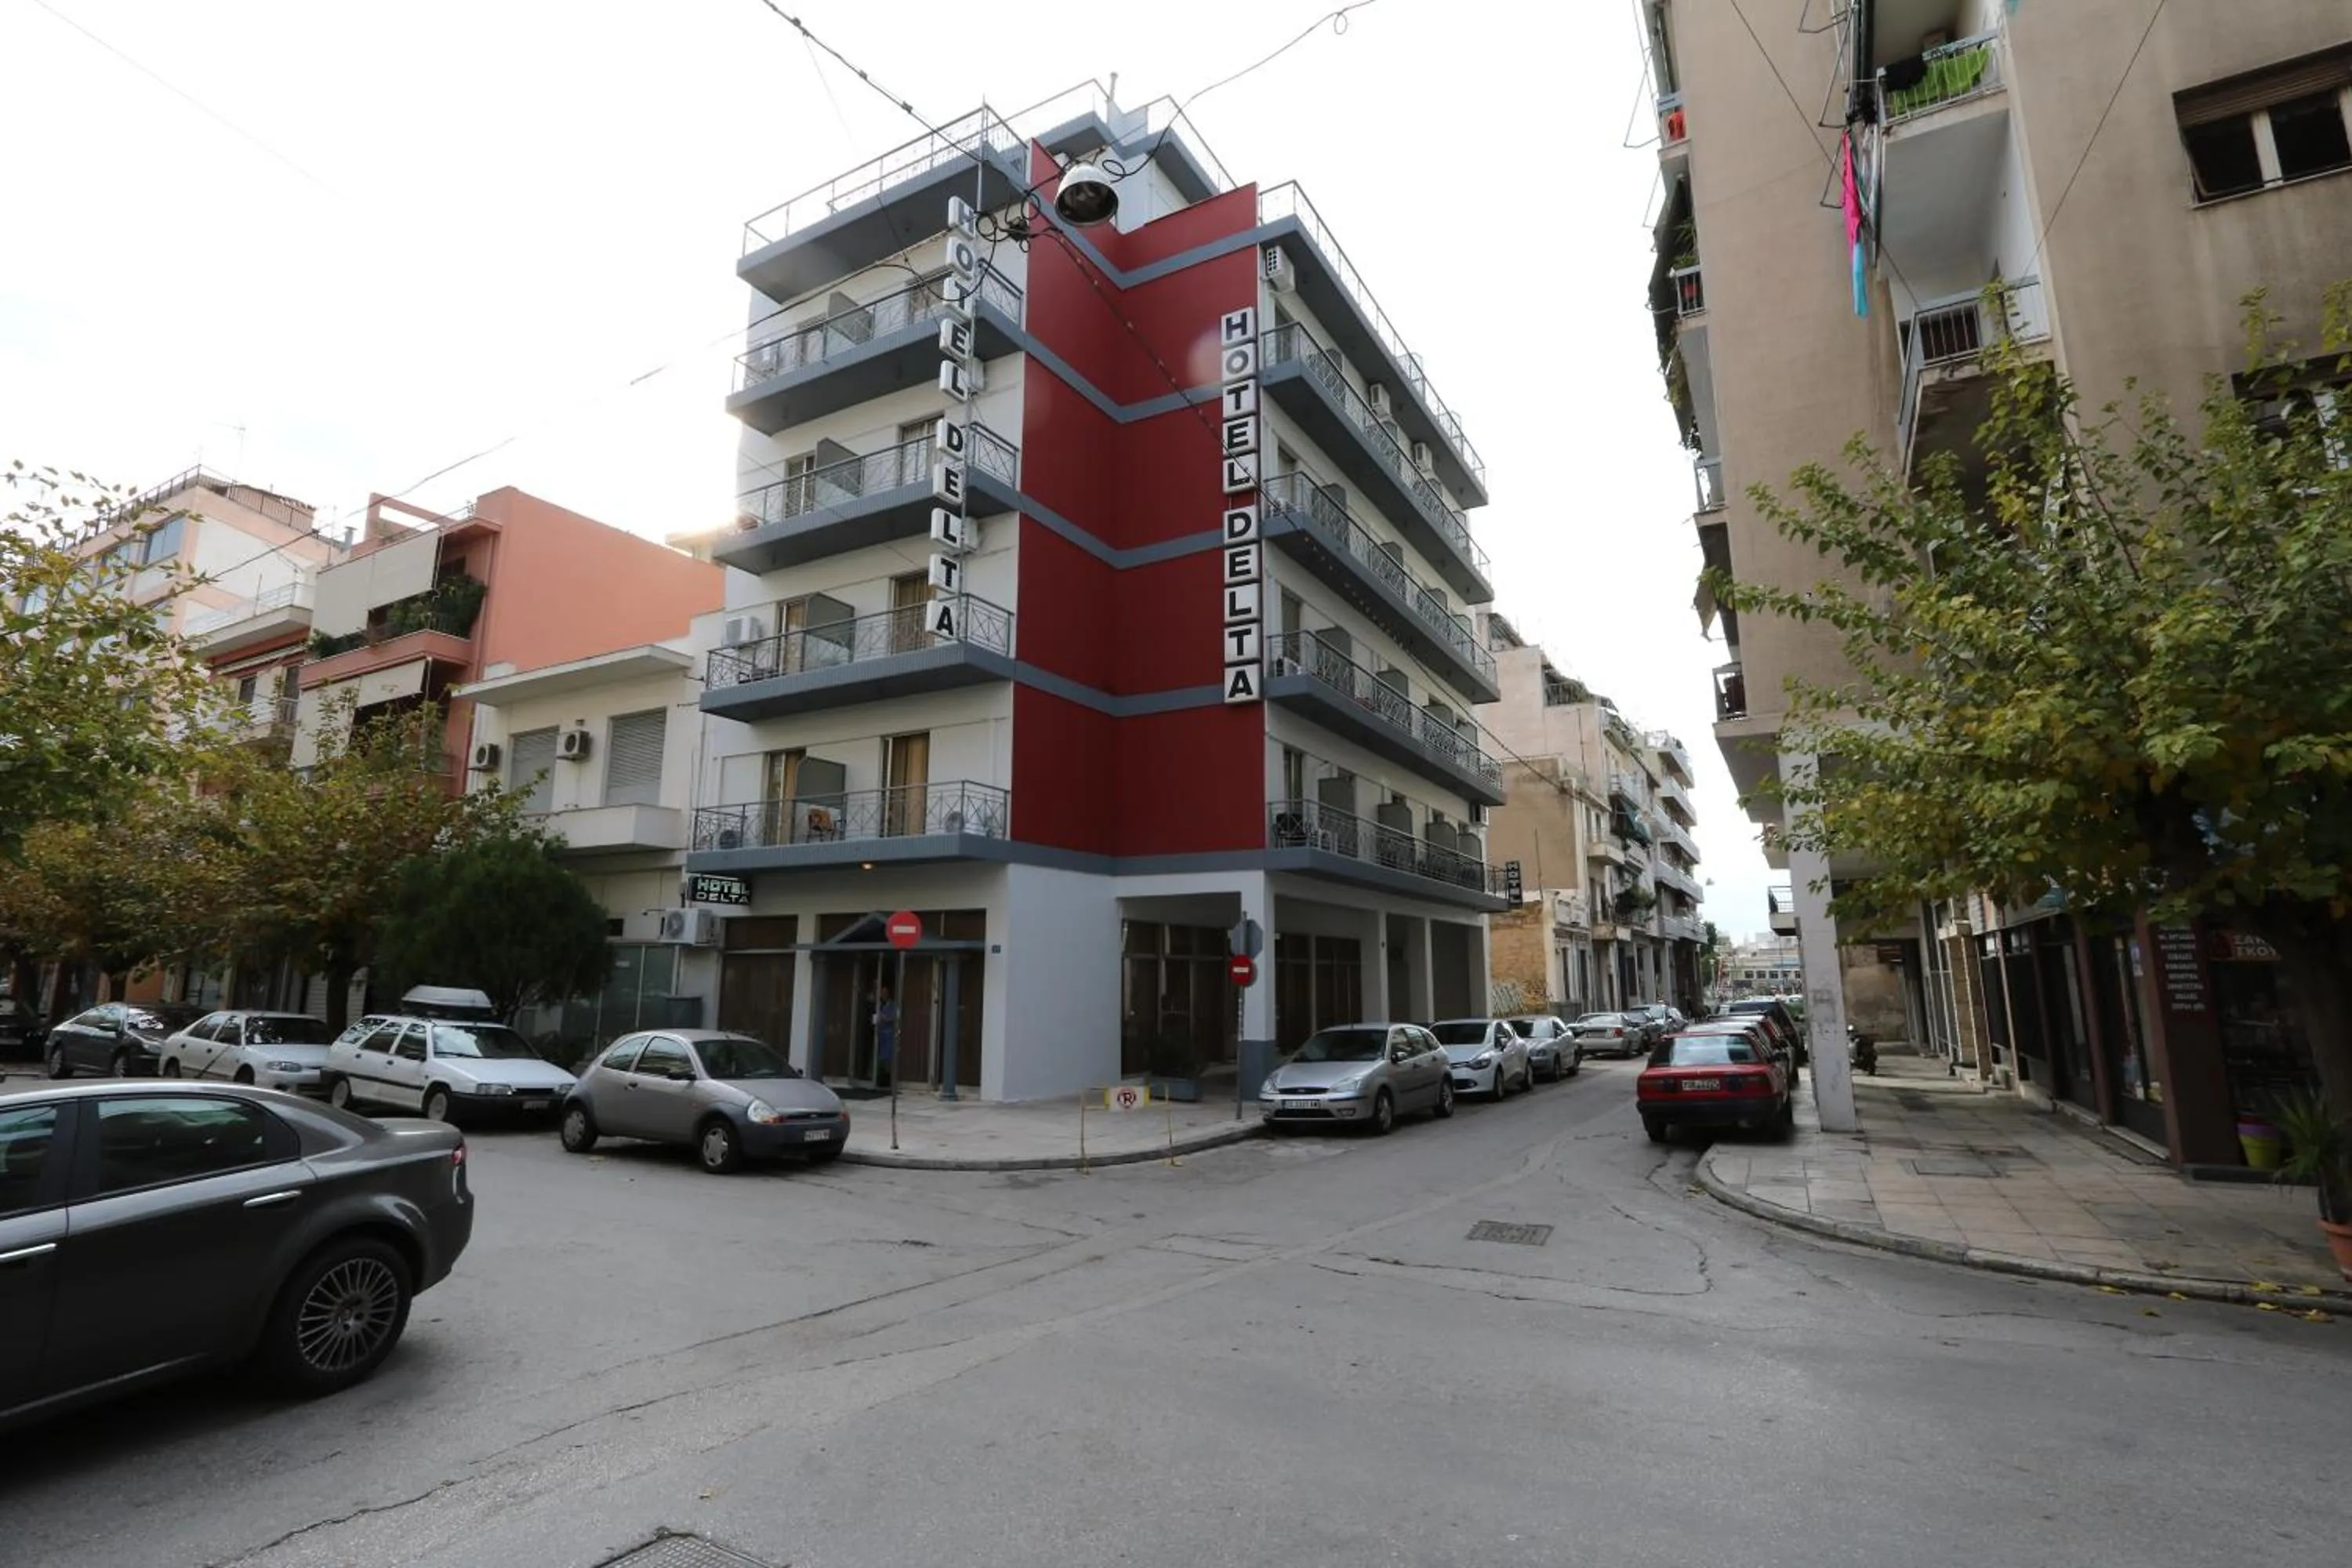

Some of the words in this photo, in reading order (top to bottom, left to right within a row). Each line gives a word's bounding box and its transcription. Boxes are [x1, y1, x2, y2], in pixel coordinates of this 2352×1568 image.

[950, 199, 975, 397] HOTEL
[1225, 311, 1251, 488] HOTEL
[935, 423, 964, 636] DELTA
[1228, 511, 1254, 699] DELTA
[695, 891, 750, 905] DELTA
[697, 877, 750, 896] HOTEL
[1508, 863, 1520, 903] HOTEL
